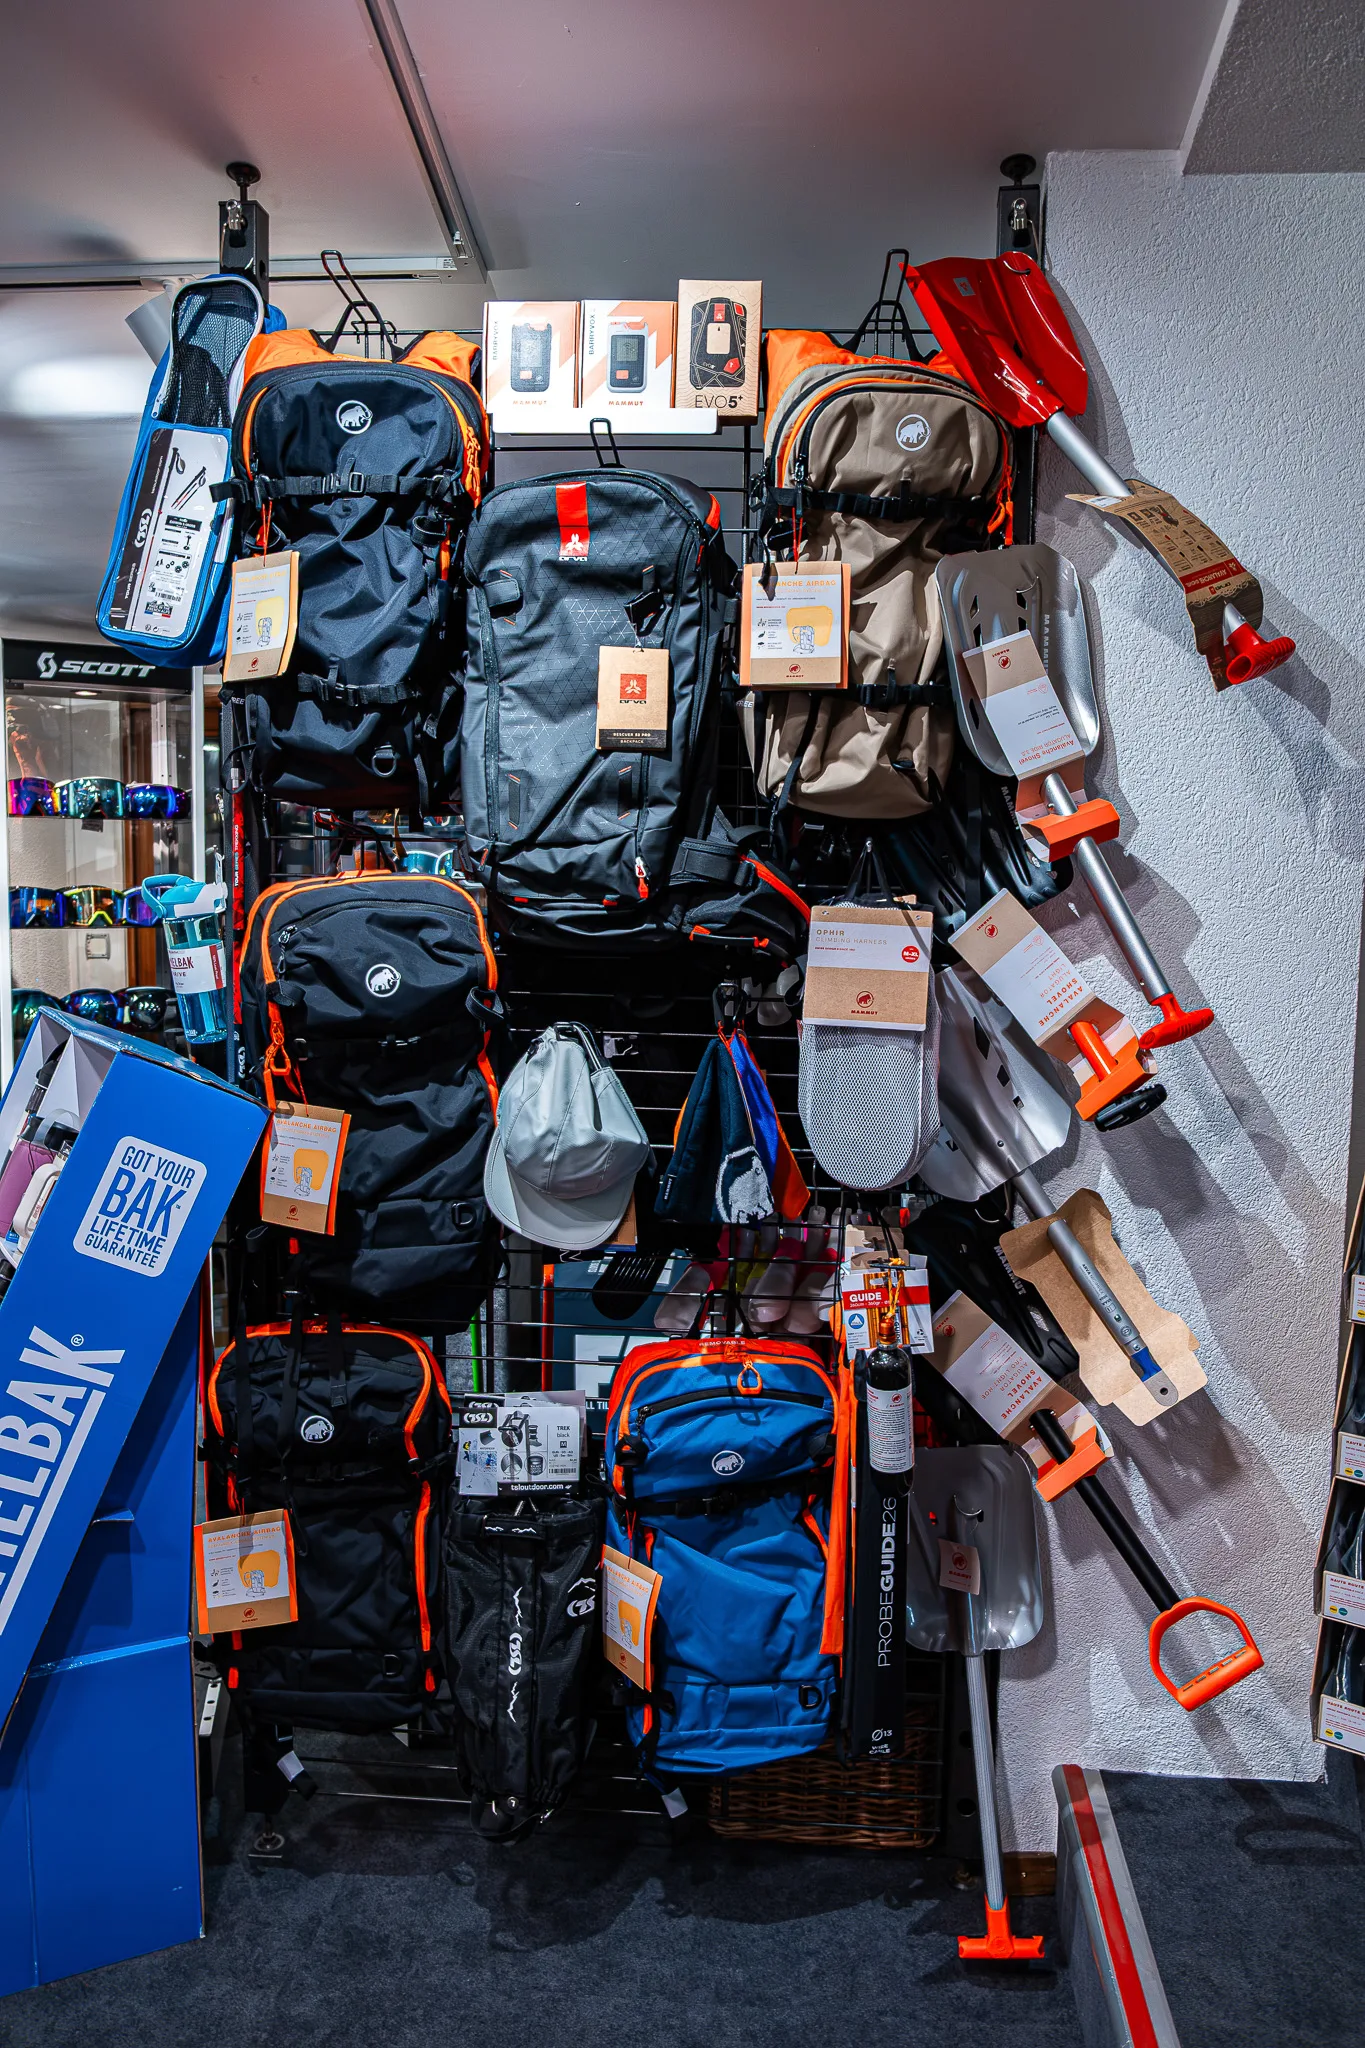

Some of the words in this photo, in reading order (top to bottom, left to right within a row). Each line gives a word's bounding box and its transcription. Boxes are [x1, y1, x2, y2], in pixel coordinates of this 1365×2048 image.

[588, 314, 596, 355] BARRYVOX
[124, 581, 132, 599] TOUR
[59, 660, 156, 678] SCOTT
[231, 697, 245, 705] REE
[1017, 751, 1041, 765] Shovel
[1040, 738, 1075, 756] Avalanche
[1001, 786, 1020, 830] MAMMU
[170, 956, 193, 969] ELBAK
[1038, 968, 1071, 998] ALUGATOR
[1044, 976, 1078, 1006] SHOVEL
[1036, 984, 1084, 1027] AVALANCHE
[121, 1145, 155, 1172] GOT
[154, 1156, 196, 1189] YOUR
[90, 1215, 167, 1254] LIFETIME
[84, 1233, 159, 1269] GUARANTEE
[849, 1291, 882, 1303] GUIDE
[999, 1375, 1043, 1420] AVALANCHE
[1006, 1368, 1036, 1399] SHOVEL
[510, 1483, 564, 1491] tsloutdoor.com
